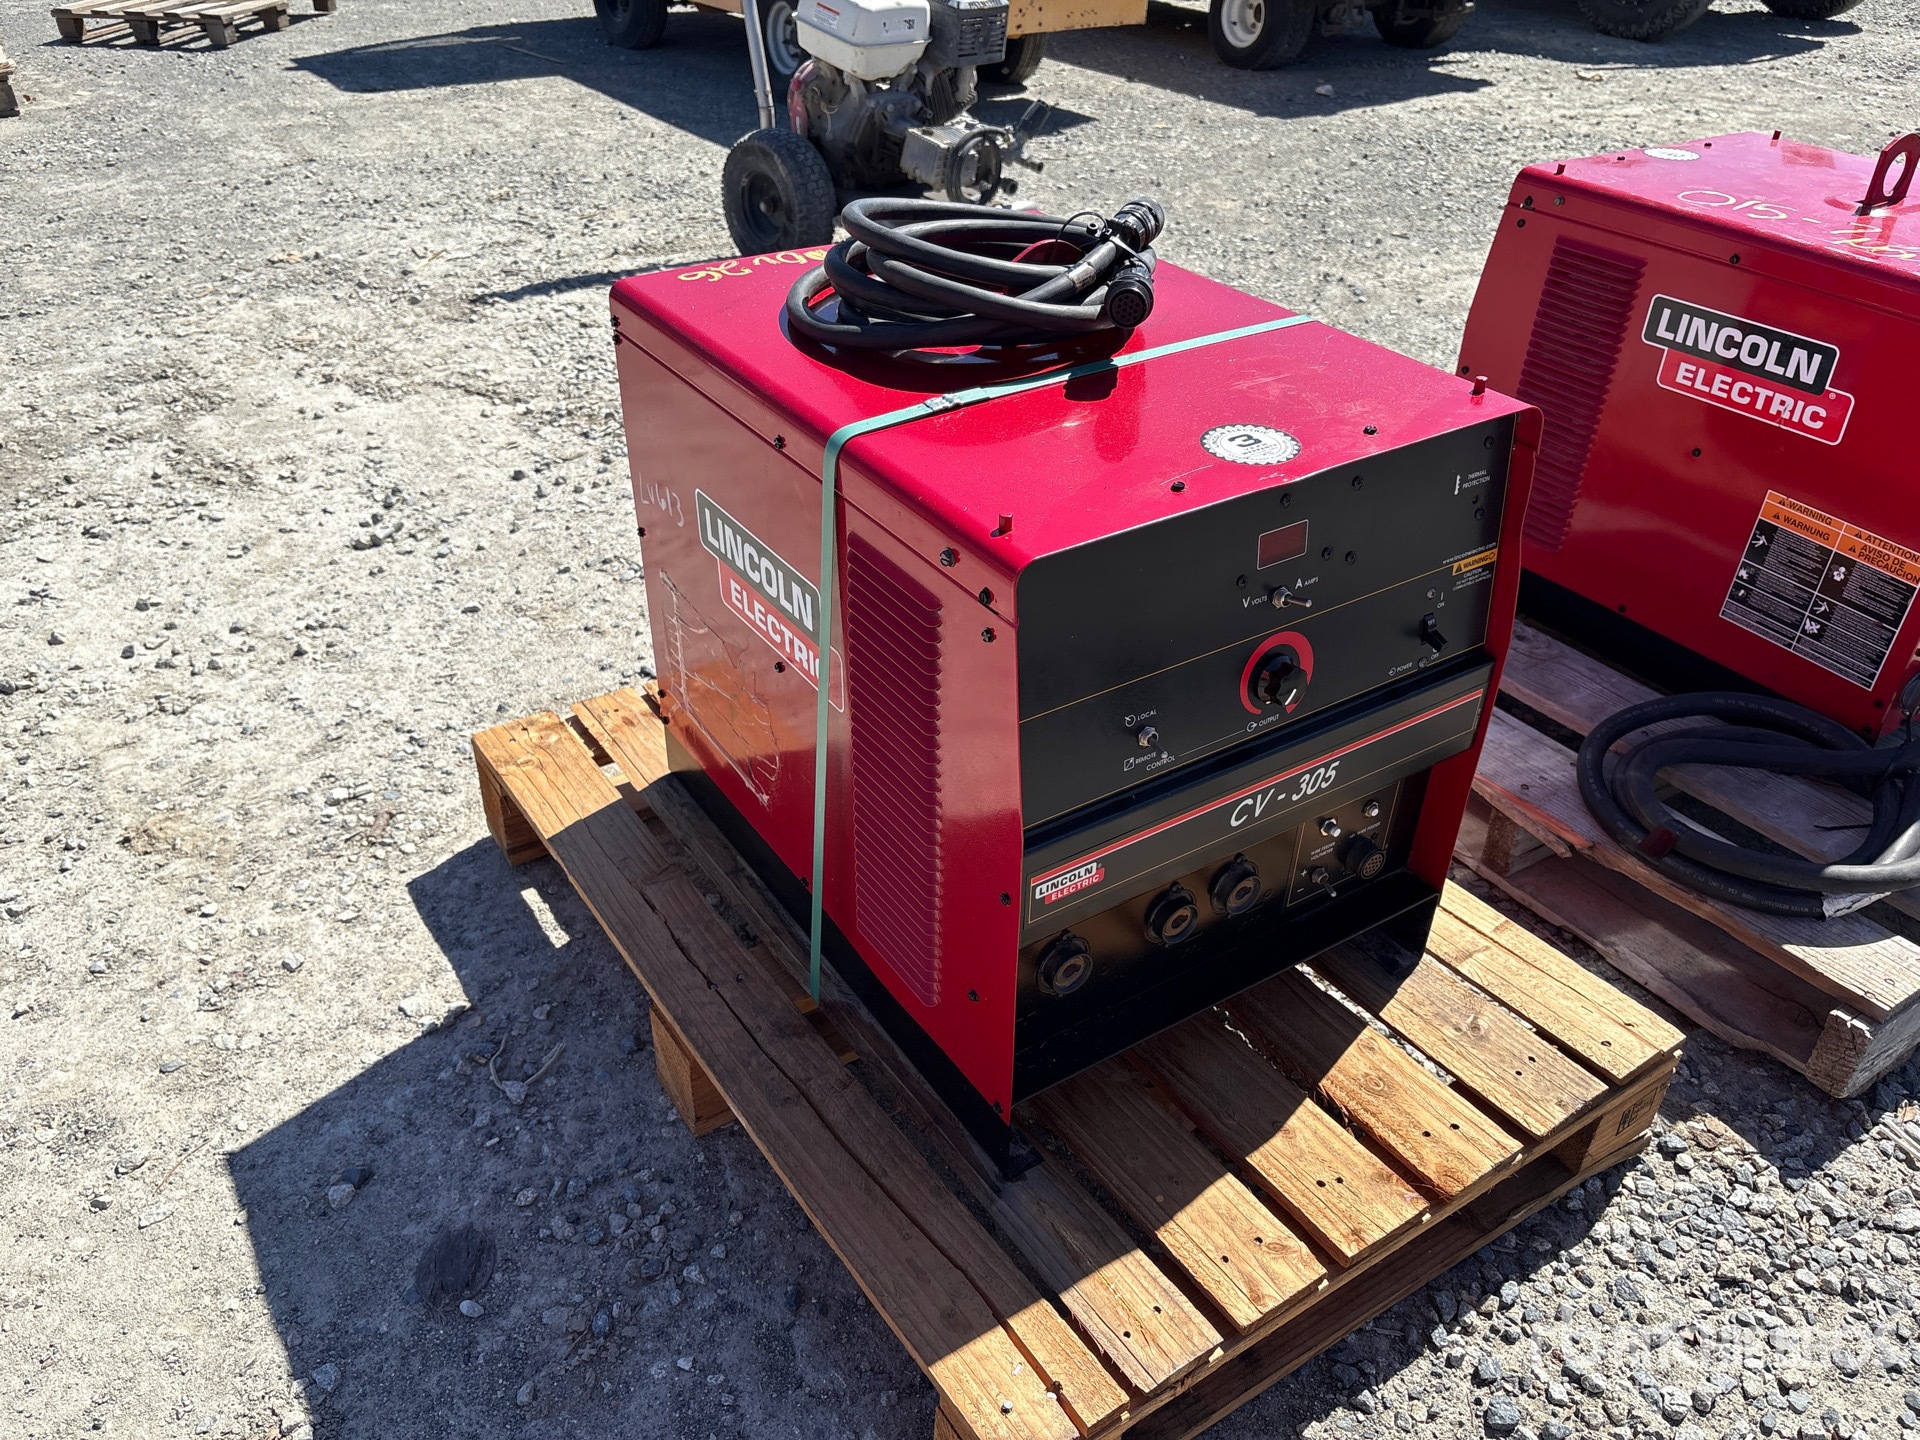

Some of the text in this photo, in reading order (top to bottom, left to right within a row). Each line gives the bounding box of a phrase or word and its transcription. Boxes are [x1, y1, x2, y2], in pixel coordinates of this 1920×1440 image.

[1656, 307, 1822, 385] LINCOLN
[1675, 361, 1827, 430] ELECTRIC
[1462, 475, 1491, 489] PROTECTION
[1789, 500, 1833, 526] WARNING
[1783, 515, 1831, 541] WARNUNG
[1860, 543, 1906, 570] AVISO DE
[1865, 535, 1920, 563] ATTENTION
[705, 507, 814, 632] LINCOLN
[1463, 554, 1489, 569] WARNING
[1294, 576, 1319, 589] A AMPS
[1242, 595, 1268, 609] V VOLTS
[1437, 601, 1446, 609] ON
[729, 578, 821, 680] ELECTRI
[1396, 662, 1413, 673] POWER
[1137, 709, 1158, 721] LOCAL
[1258, 713, 1280, 727] OUTPUT
[1135, 751, 1157, 765] REMOTE
[1146, 754, 1176, 771] CONTROL
[1039, 865, 1094, 896] LINCOLN
[1051, 874, 1100, 901] ELECTRIC
